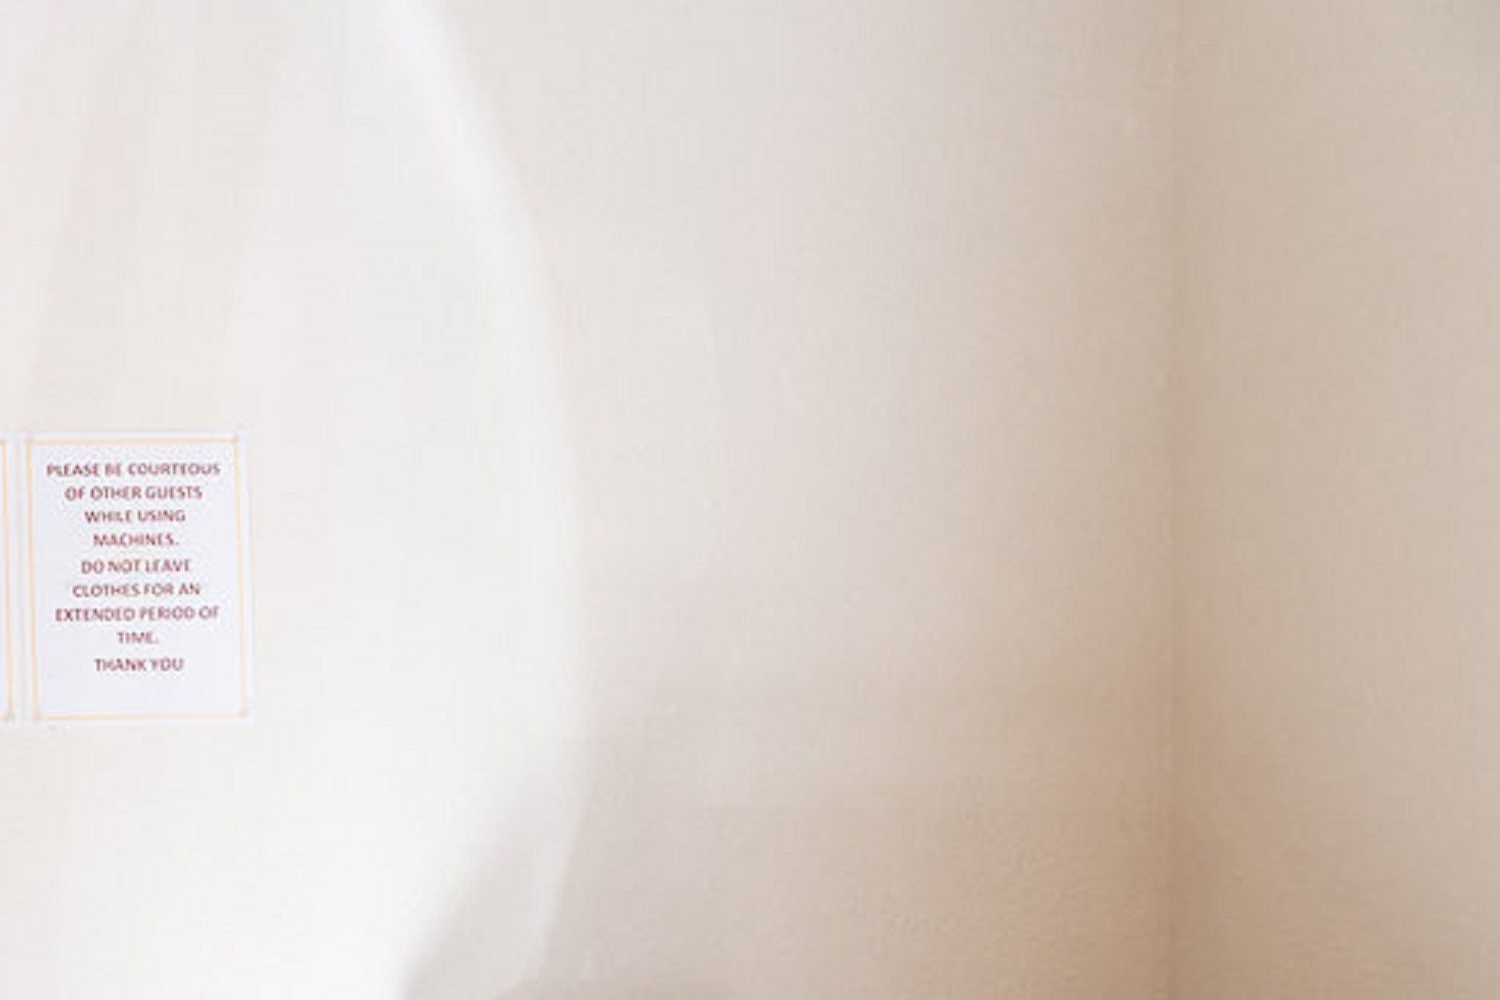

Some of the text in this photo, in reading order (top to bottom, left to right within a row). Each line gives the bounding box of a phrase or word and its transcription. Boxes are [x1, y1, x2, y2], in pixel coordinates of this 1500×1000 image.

[46, 463, 221, 476] PLEASE BE COURTEOUS
[64, 486, 203, 500] OF OTHER GUESTS
[84, 510, 186, 523] WHILE USING
[93, 534, 179, 546] MACHINES.
[81, 560, 191, 574] DO NOT LEAVE
[72, 583, 200, 598] CLOTHES FOR AN
[55, 606, 220, 622] EXTENDED PERIOD OF
[94, 658, 184, 672] THANK YOU
